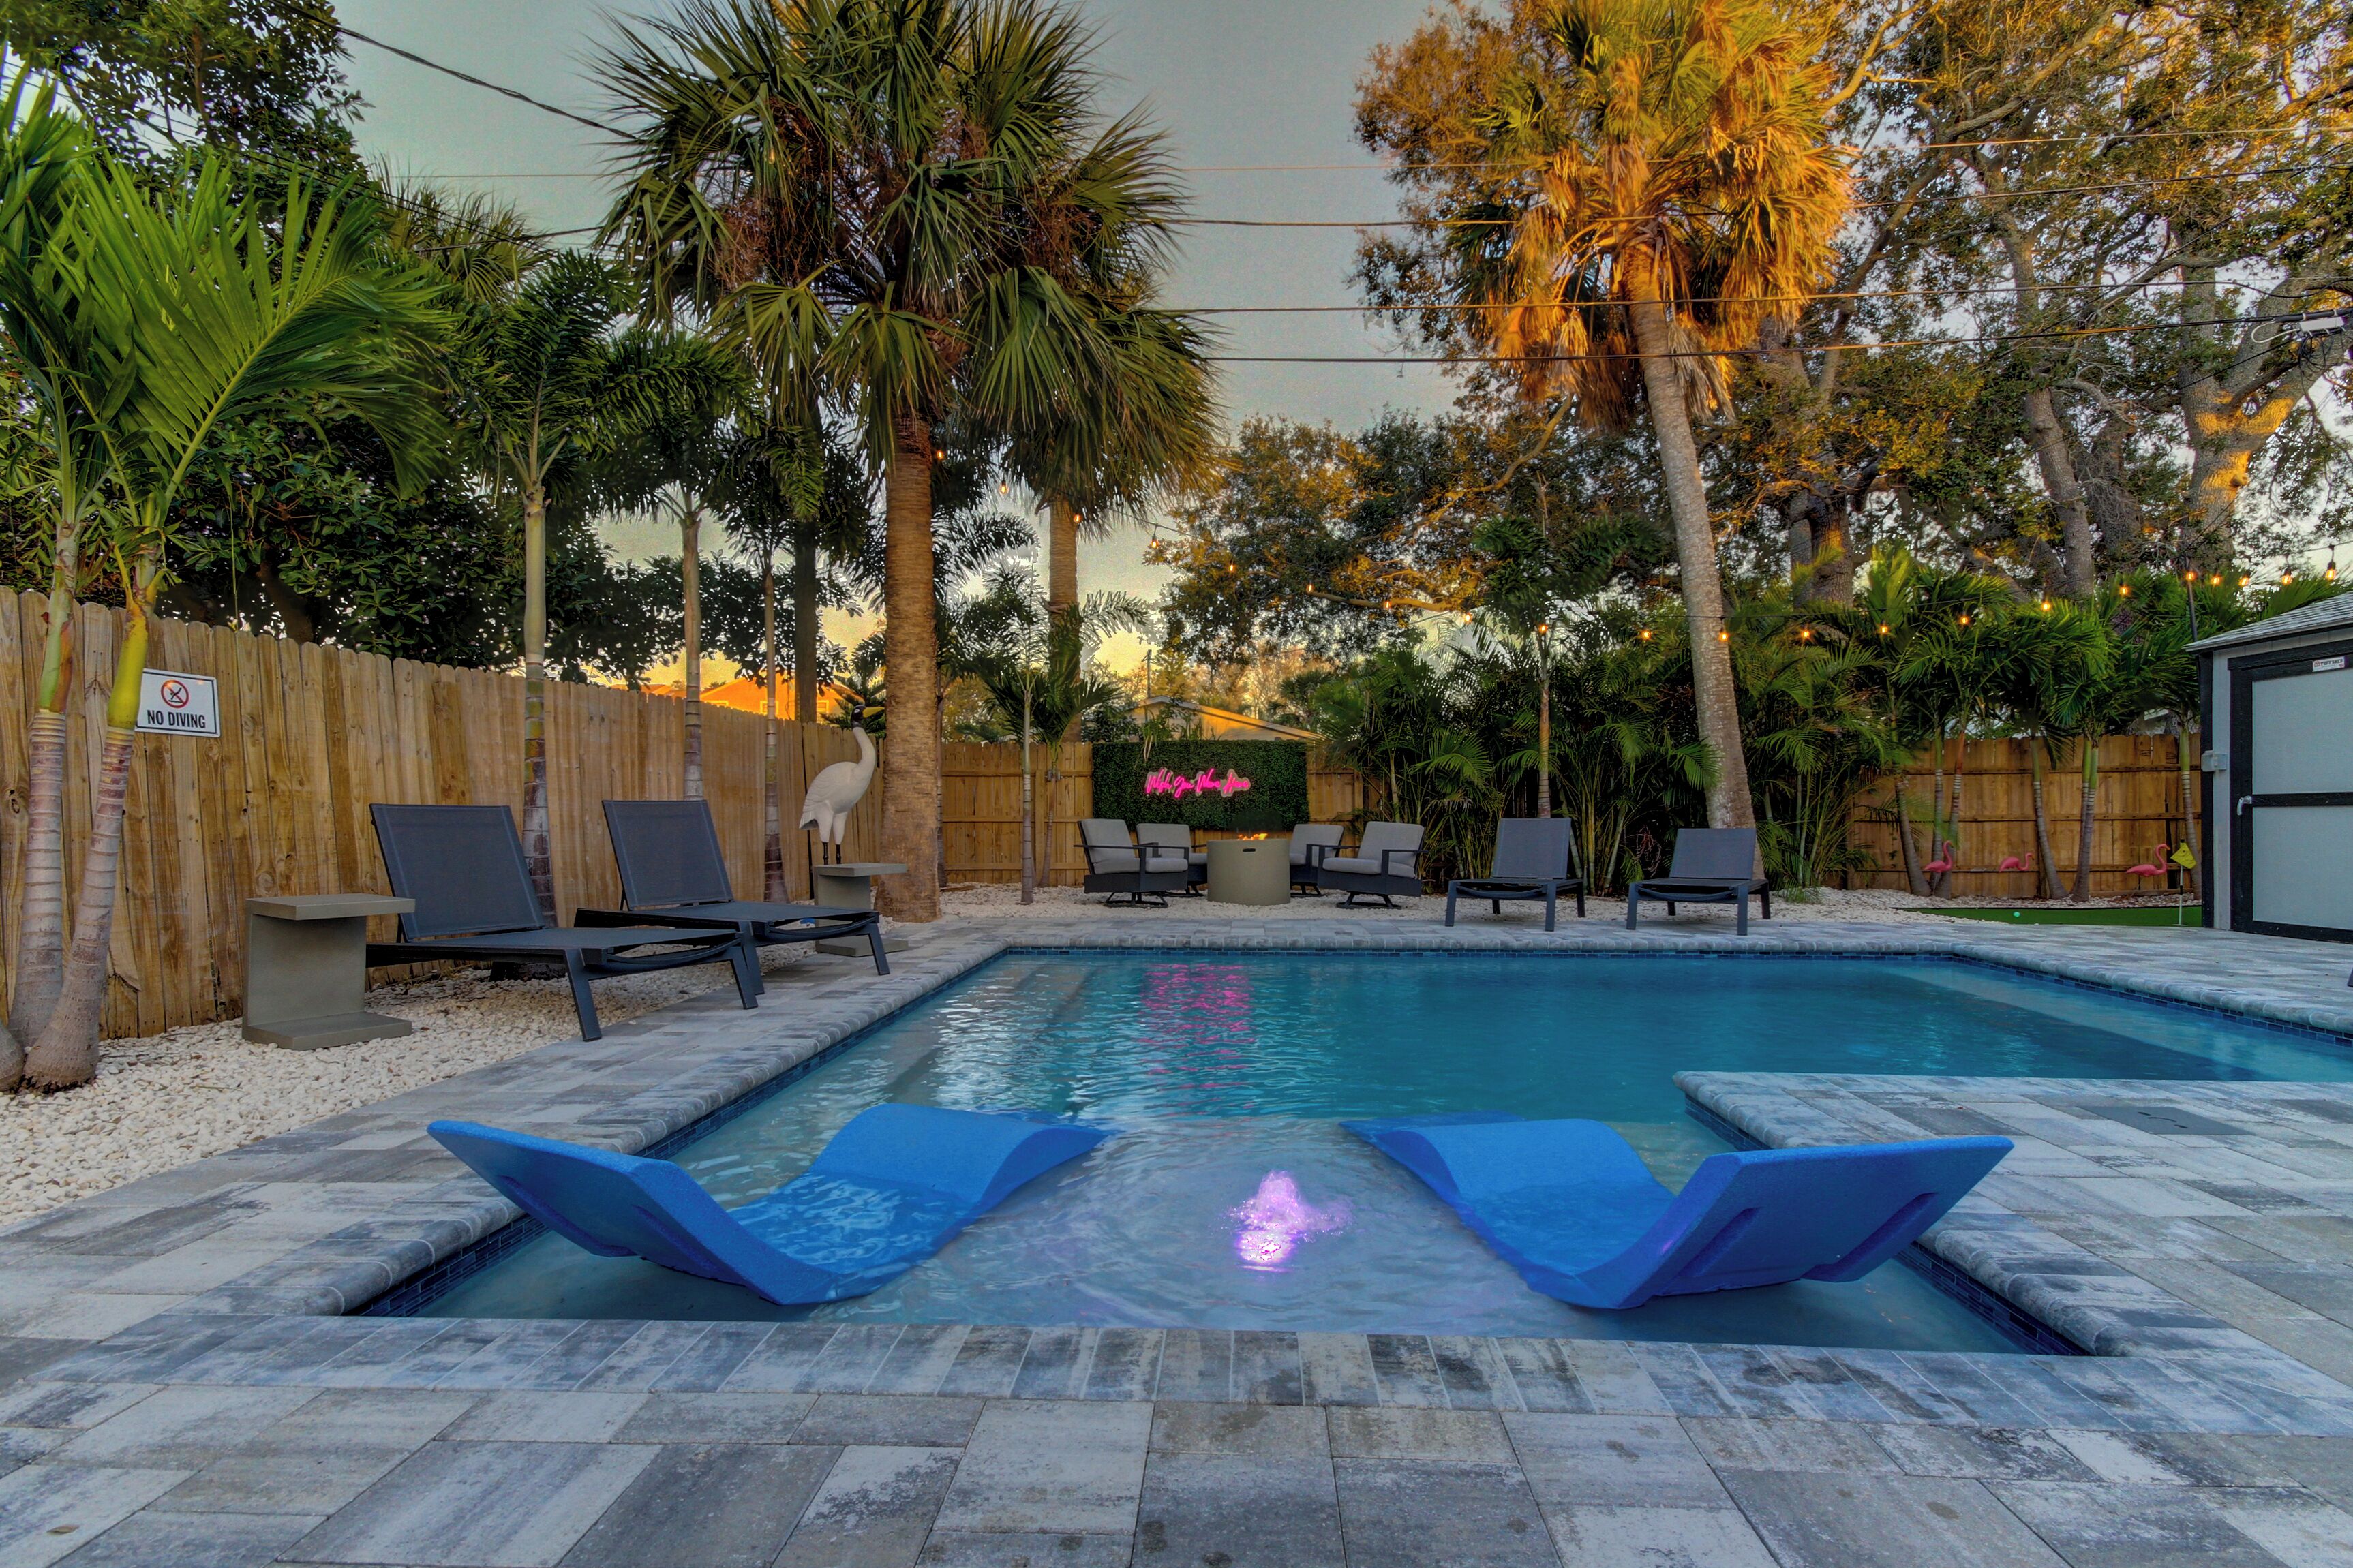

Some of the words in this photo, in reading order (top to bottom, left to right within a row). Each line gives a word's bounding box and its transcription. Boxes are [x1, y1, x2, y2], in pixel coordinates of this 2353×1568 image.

[147, 709, 164, 725] NO
[168, 711, 206, 728] DIVING
[1173, 775, 1195, 799] You
